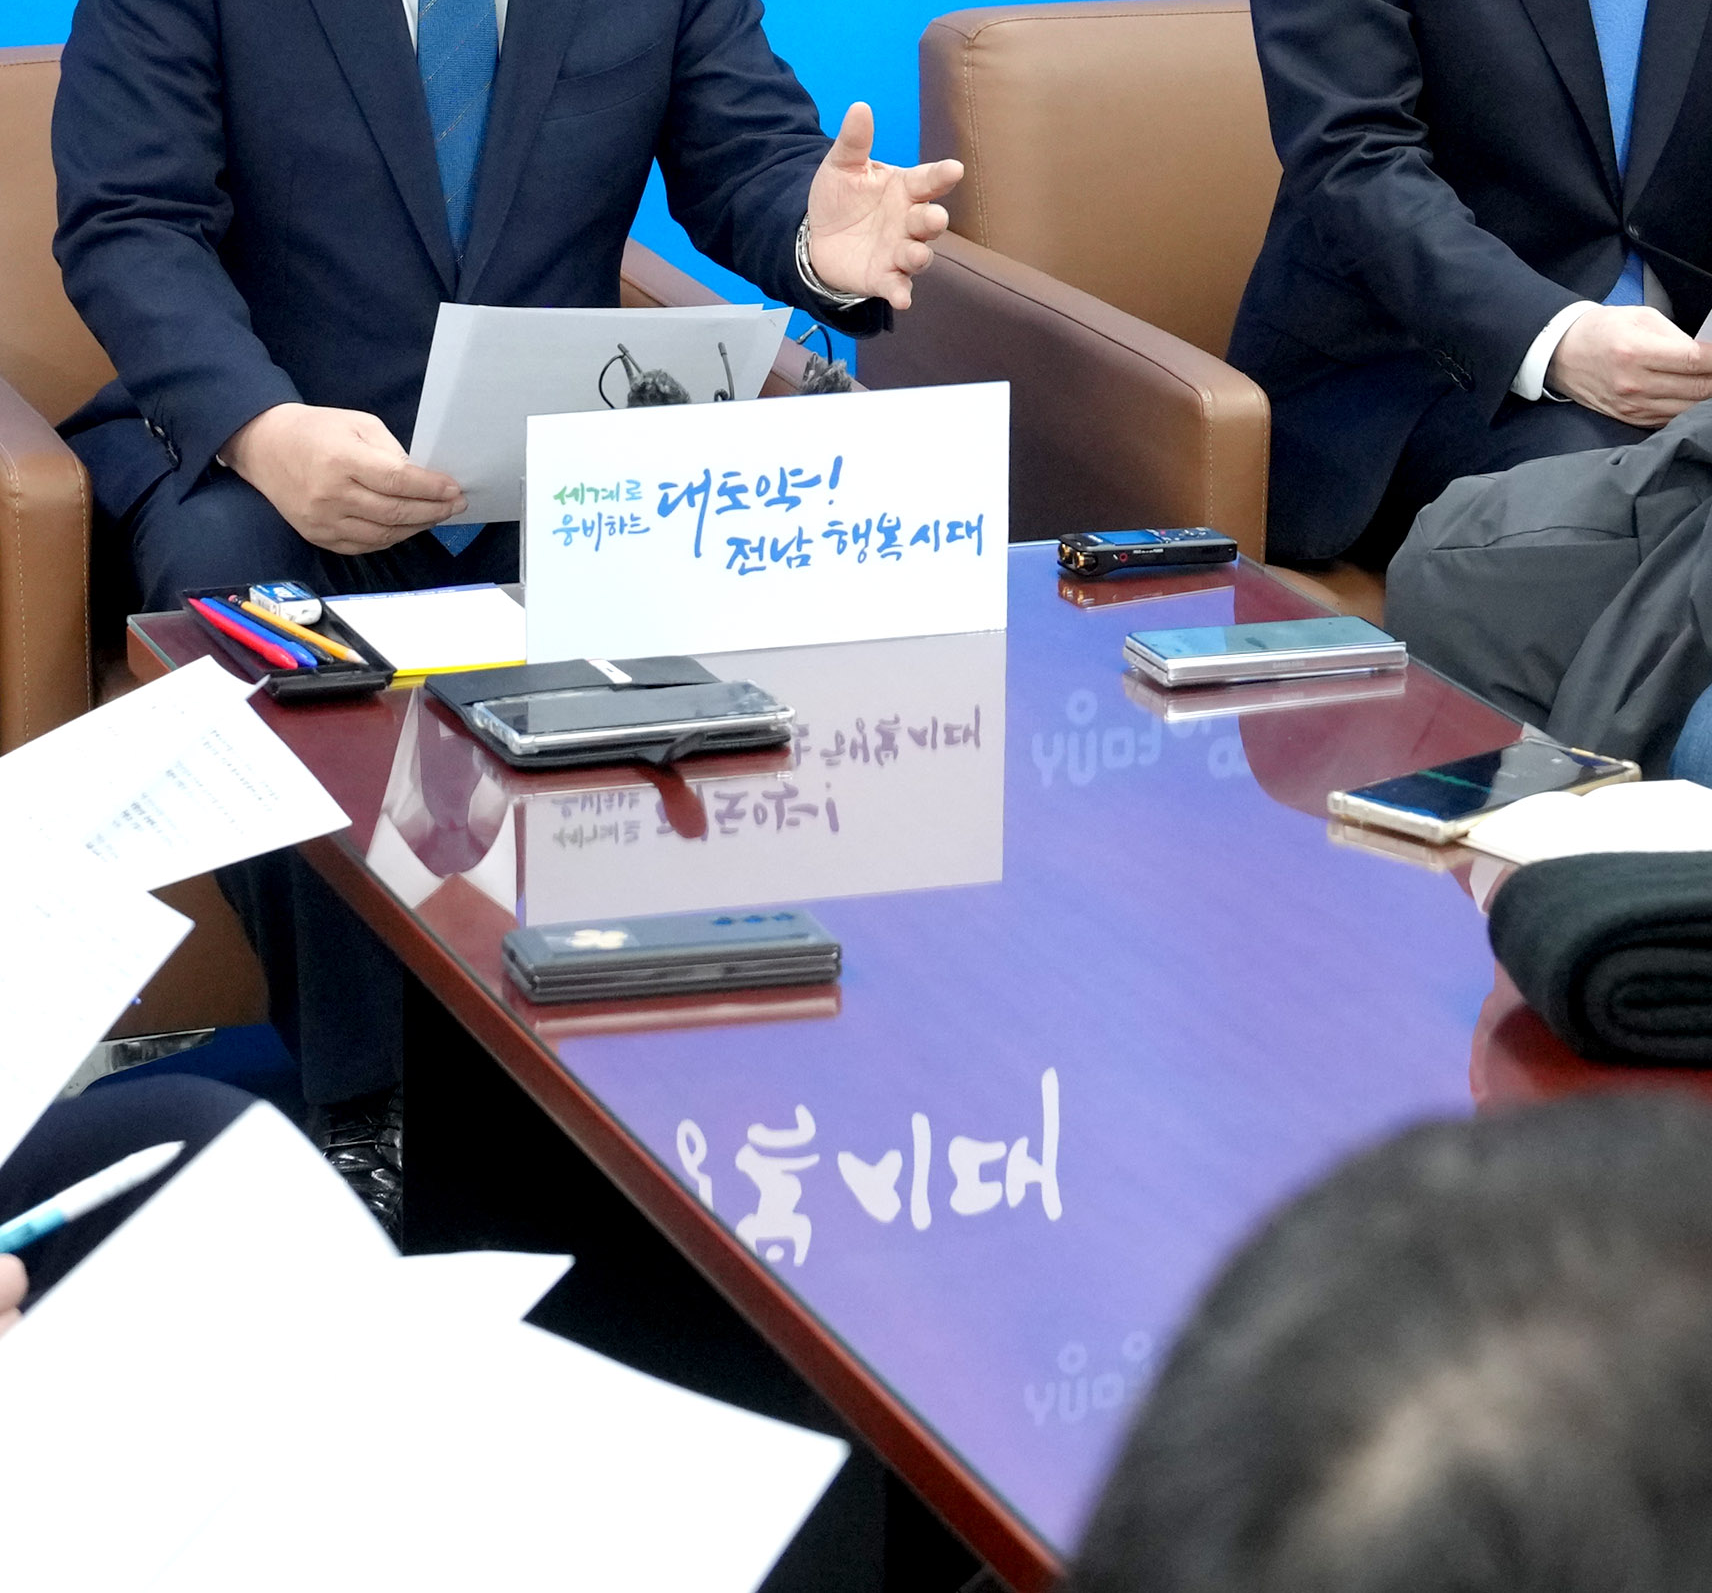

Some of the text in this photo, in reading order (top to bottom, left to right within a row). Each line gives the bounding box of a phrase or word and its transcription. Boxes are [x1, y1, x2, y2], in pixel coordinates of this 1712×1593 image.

[552, 478, 644, 506] 세계로
[656, 454, 844, 558] 대도약!
[551, 511, 651, 553] 웅비하는
[725, 526, 814, 576] 전남
